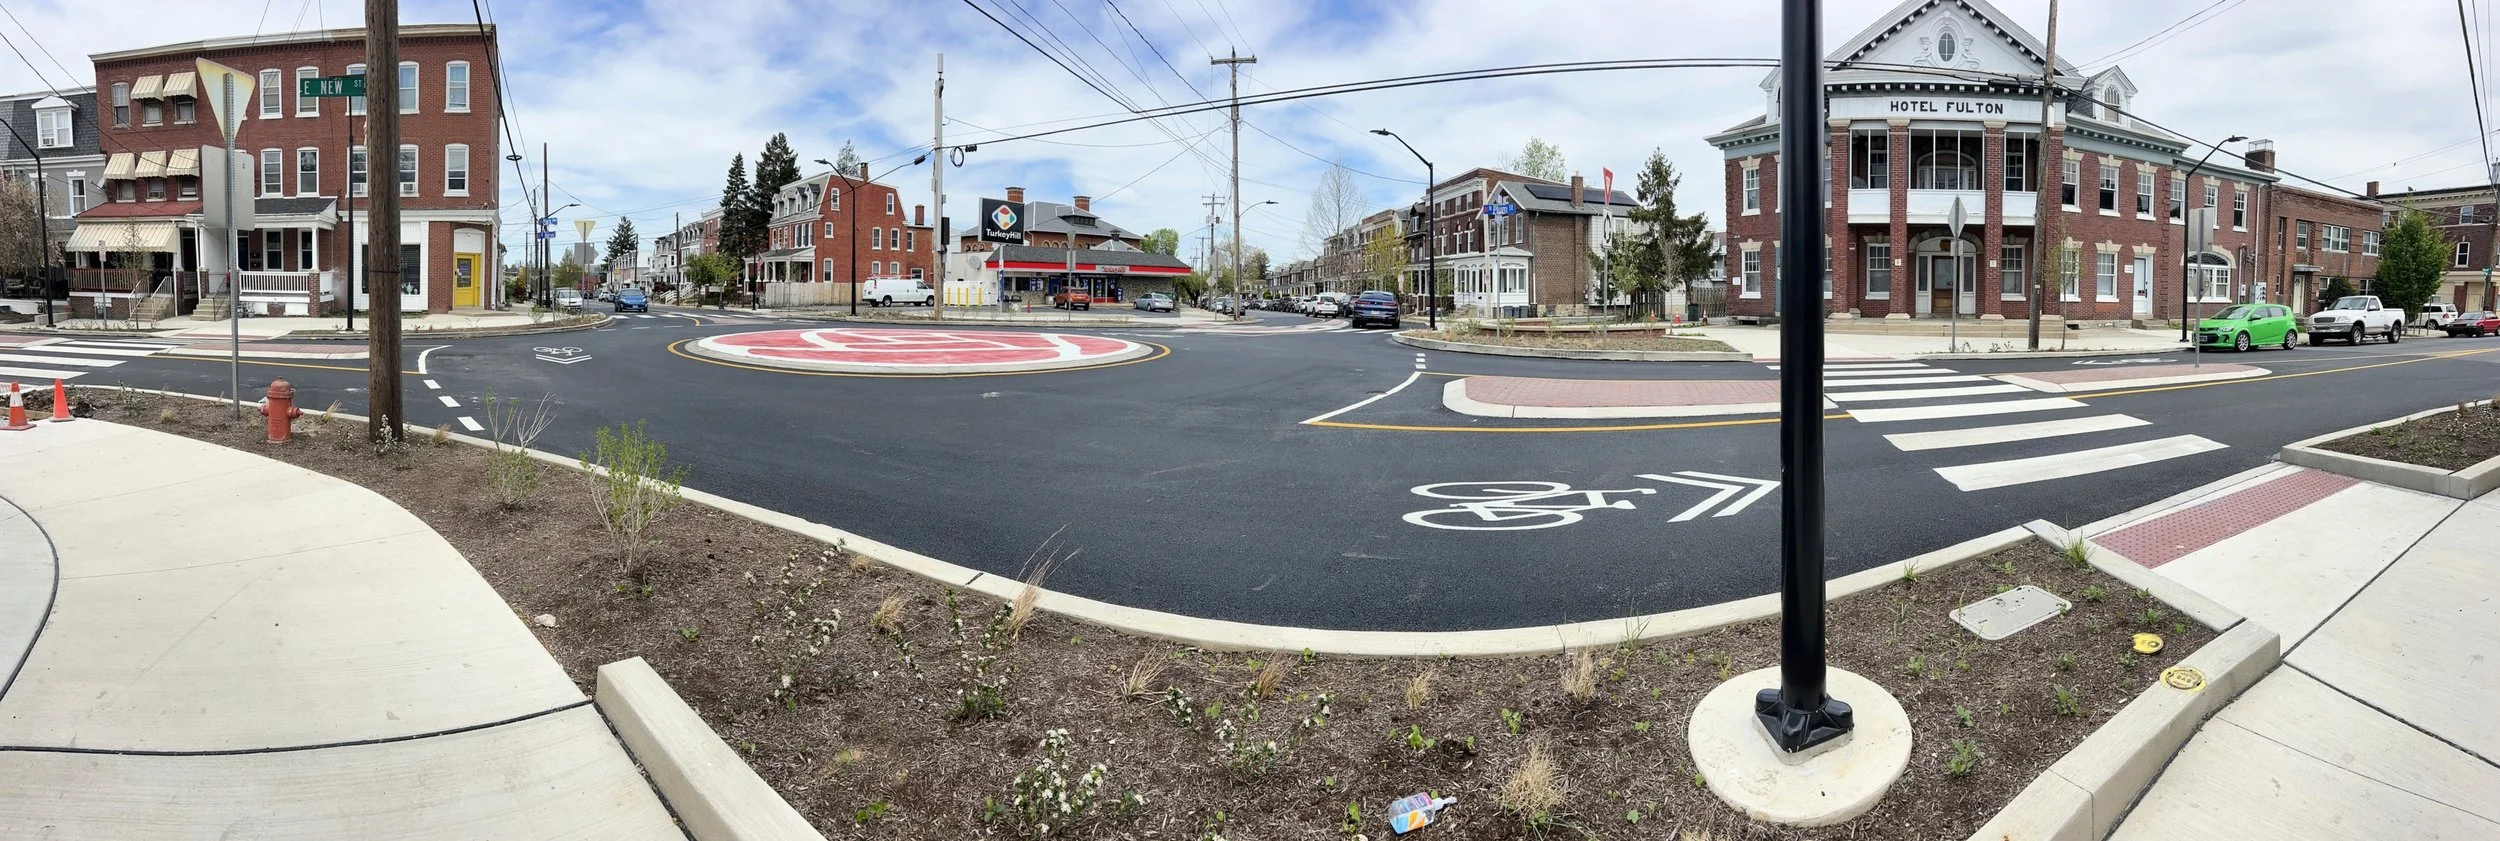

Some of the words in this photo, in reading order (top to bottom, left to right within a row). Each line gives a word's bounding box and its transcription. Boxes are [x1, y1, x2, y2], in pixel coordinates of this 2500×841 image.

[304, 80, 310, 95] E
[320, 80, 342, 95] NEW
[353, 79, 362, 88] ST
[1890, 101, 1938, 112] HOTEL
[1946, 102, 2004, 114] FULTON
[1492, 204, 1508, 214] Plum
[2176, 674, 2192, 683] GAS
